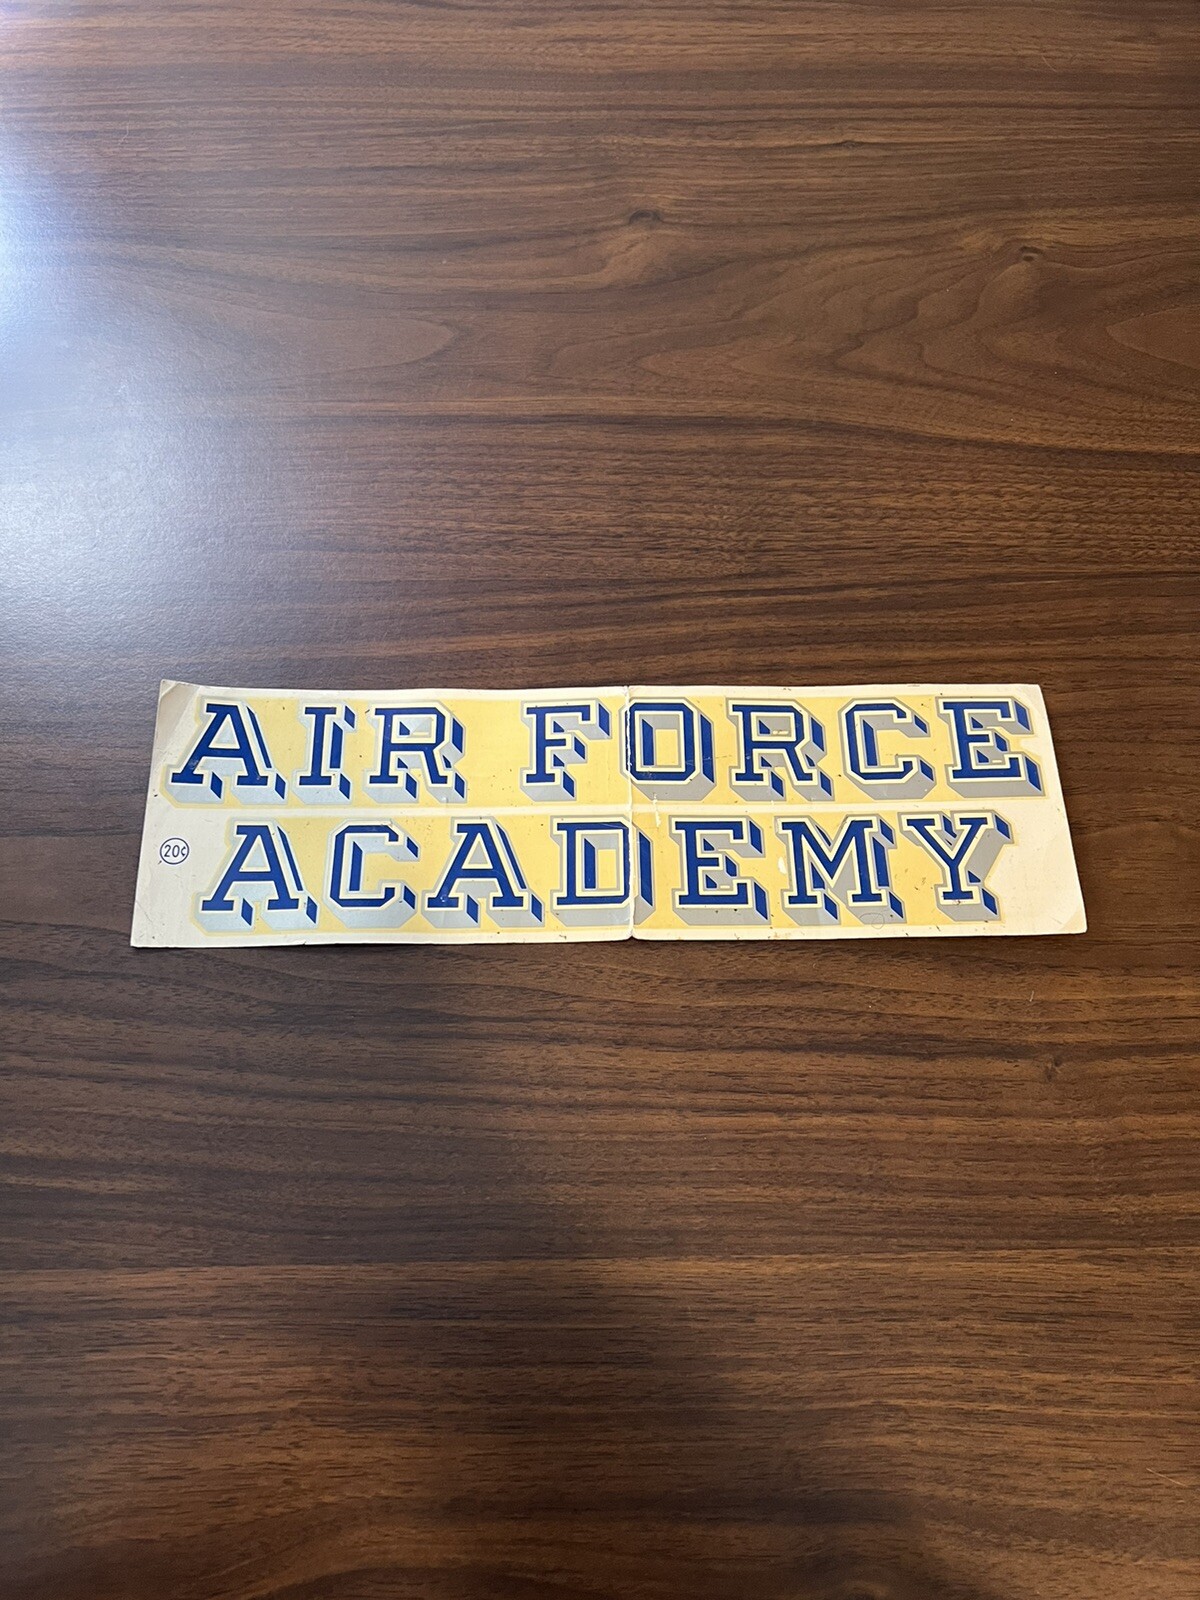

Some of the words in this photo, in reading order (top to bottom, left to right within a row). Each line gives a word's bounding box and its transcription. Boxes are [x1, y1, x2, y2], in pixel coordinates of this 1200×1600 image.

[169, 699, 466, 804] AIR
[521, 698, 1044, 800] FORCE
[198, 813, 1013, 927] ACADEMY
